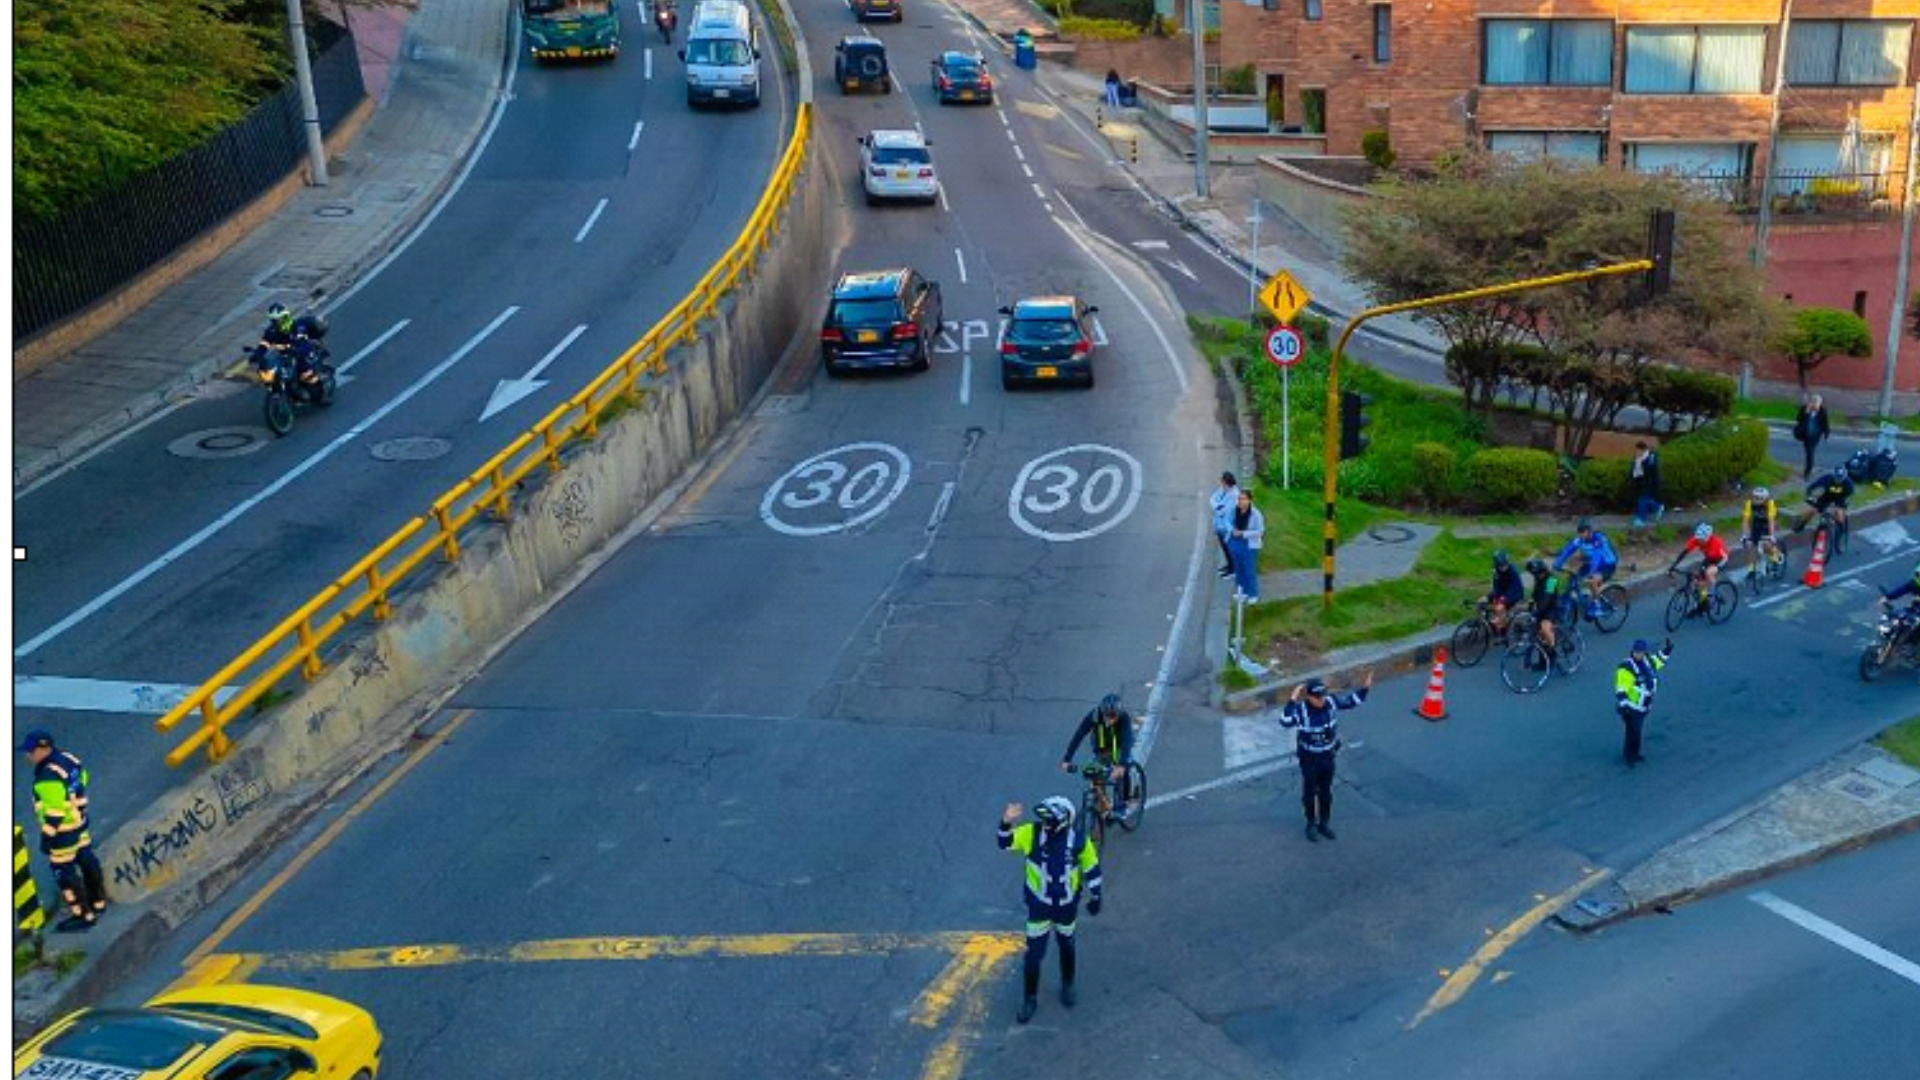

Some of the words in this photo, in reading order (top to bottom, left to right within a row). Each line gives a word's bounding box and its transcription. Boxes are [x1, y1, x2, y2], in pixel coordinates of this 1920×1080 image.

[1273, 336, 1298, 355] 30
[782, 460, 890, 509] 30
[1023, 464, 1124, 514] 30
